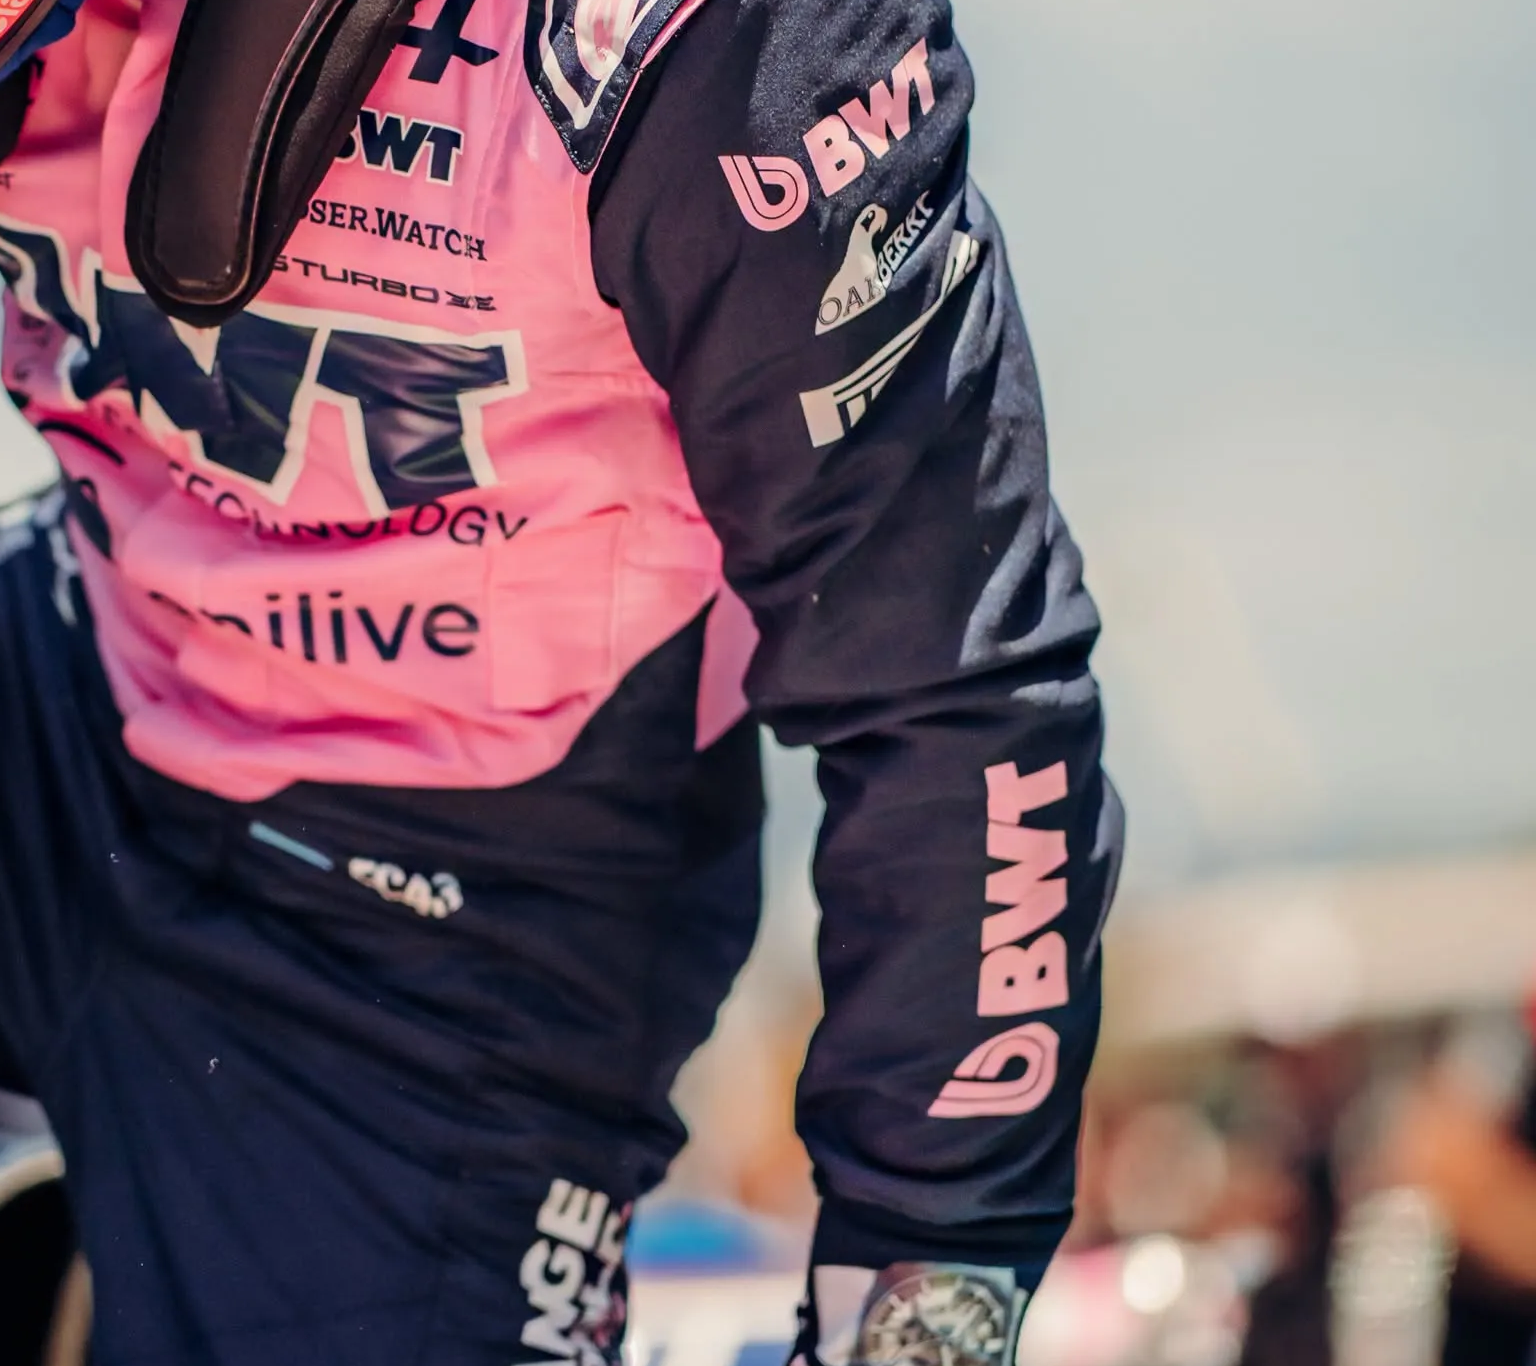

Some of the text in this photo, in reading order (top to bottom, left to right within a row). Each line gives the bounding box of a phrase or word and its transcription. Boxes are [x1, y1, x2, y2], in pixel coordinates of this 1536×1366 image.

[802, 37, 935, 198] BWT
[300, 198, 488, 262] SER.WATCH
[149, 589, 481, 666] ilive
[977, 761, 1069, 1017] BWT
